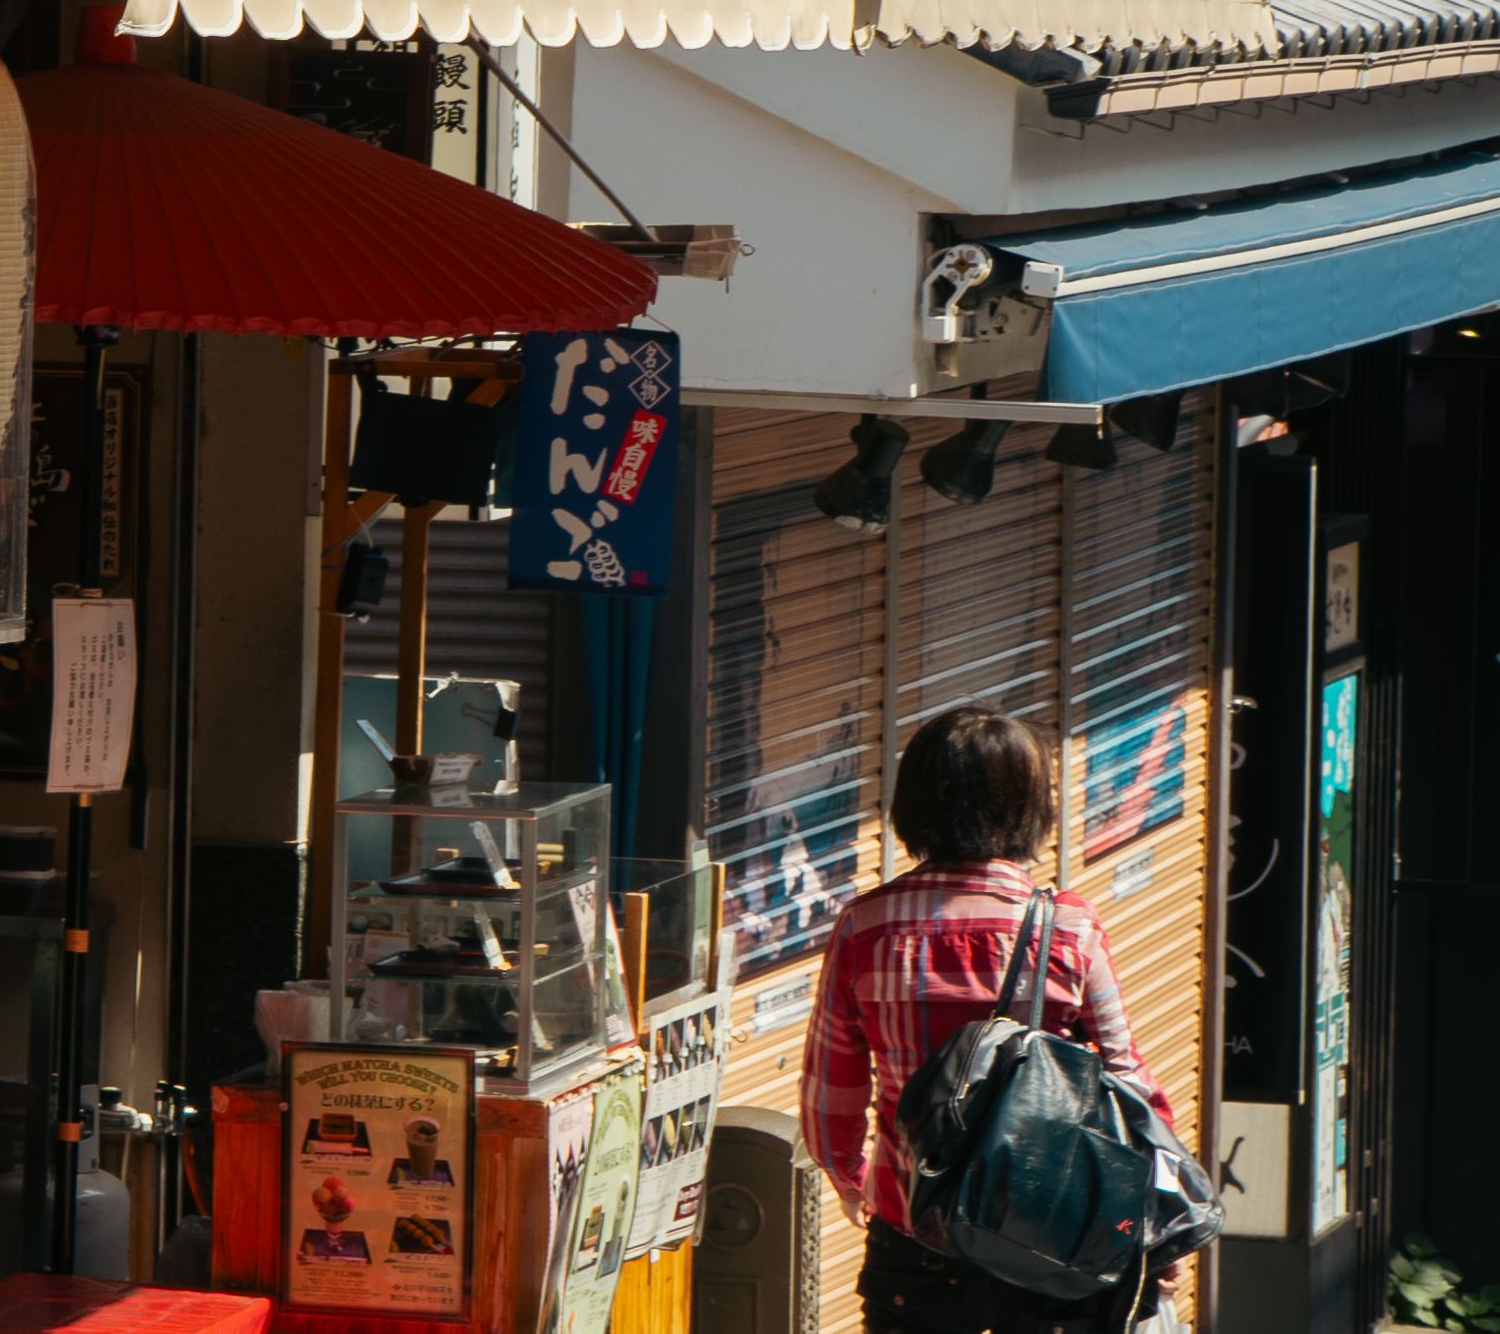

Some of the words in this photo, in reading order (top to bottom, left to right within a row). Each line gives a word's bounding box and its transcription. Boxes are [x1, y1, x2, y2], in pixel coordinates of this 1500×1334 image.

[640, 345, 659, 403] 名物
[547, 337, 630, 580] だんご
[608, 418, 659, 501] 味自慢
